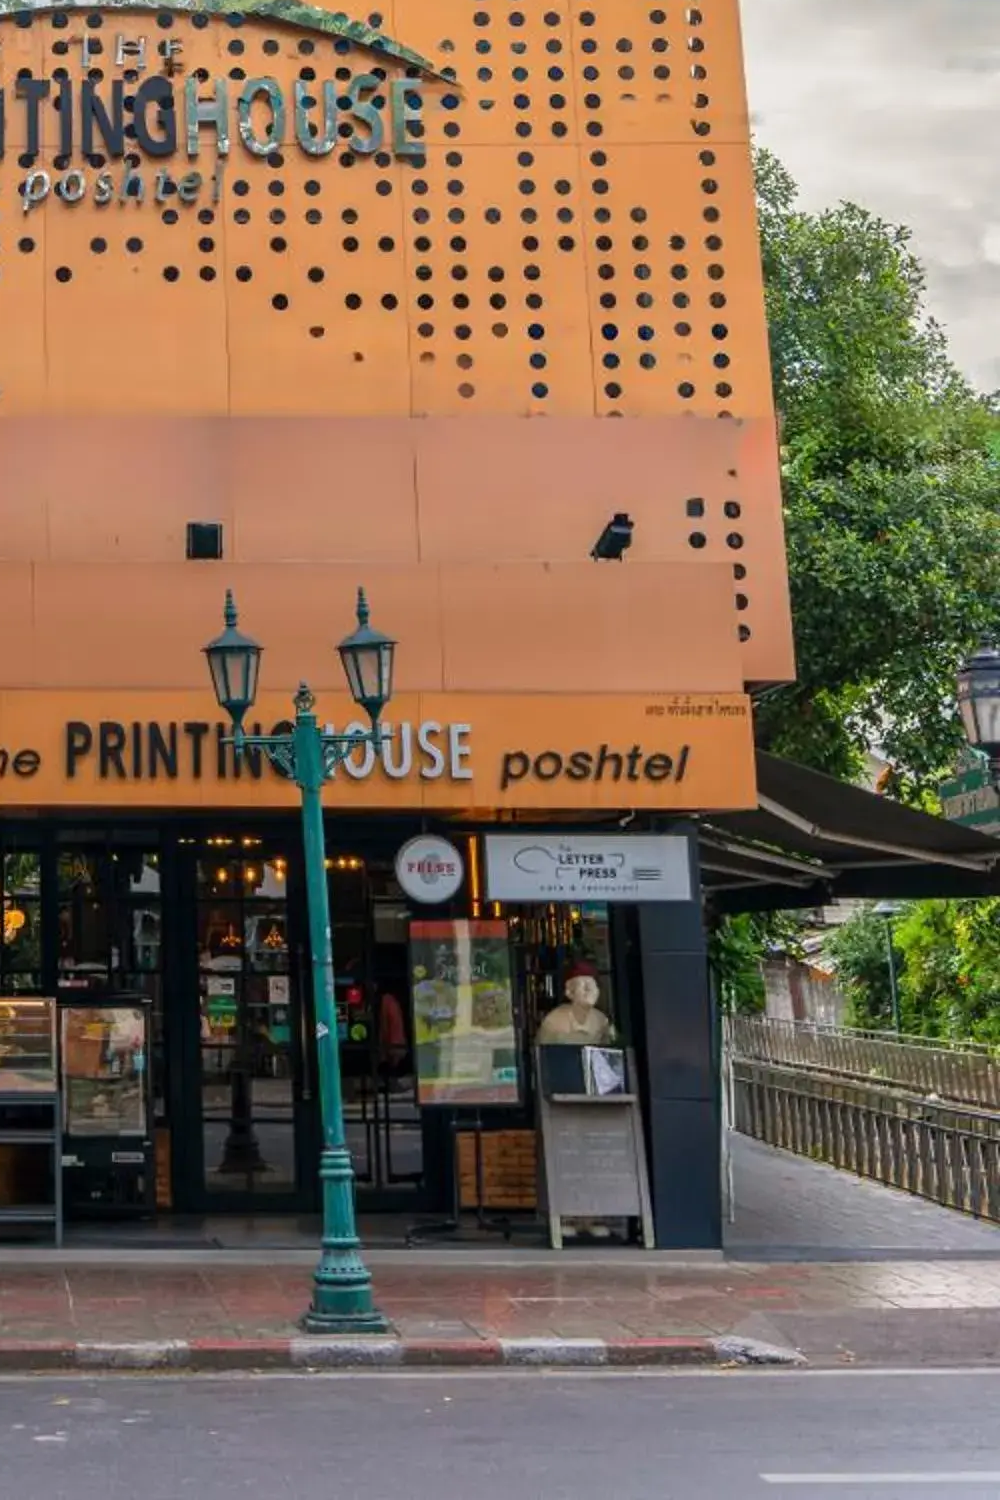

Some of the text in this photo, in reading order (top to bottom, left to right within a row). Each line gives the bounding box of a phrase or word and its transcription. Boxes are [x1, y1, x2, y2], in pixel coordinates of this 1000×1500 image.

[74, 33, 185, 71] THE
[20, 157, 227, 214] poshtel
[500, 744, 691, 791] poshtel
[558, 853, 605, 866] LETTER
[578, 867, 617, 880] PRESS
